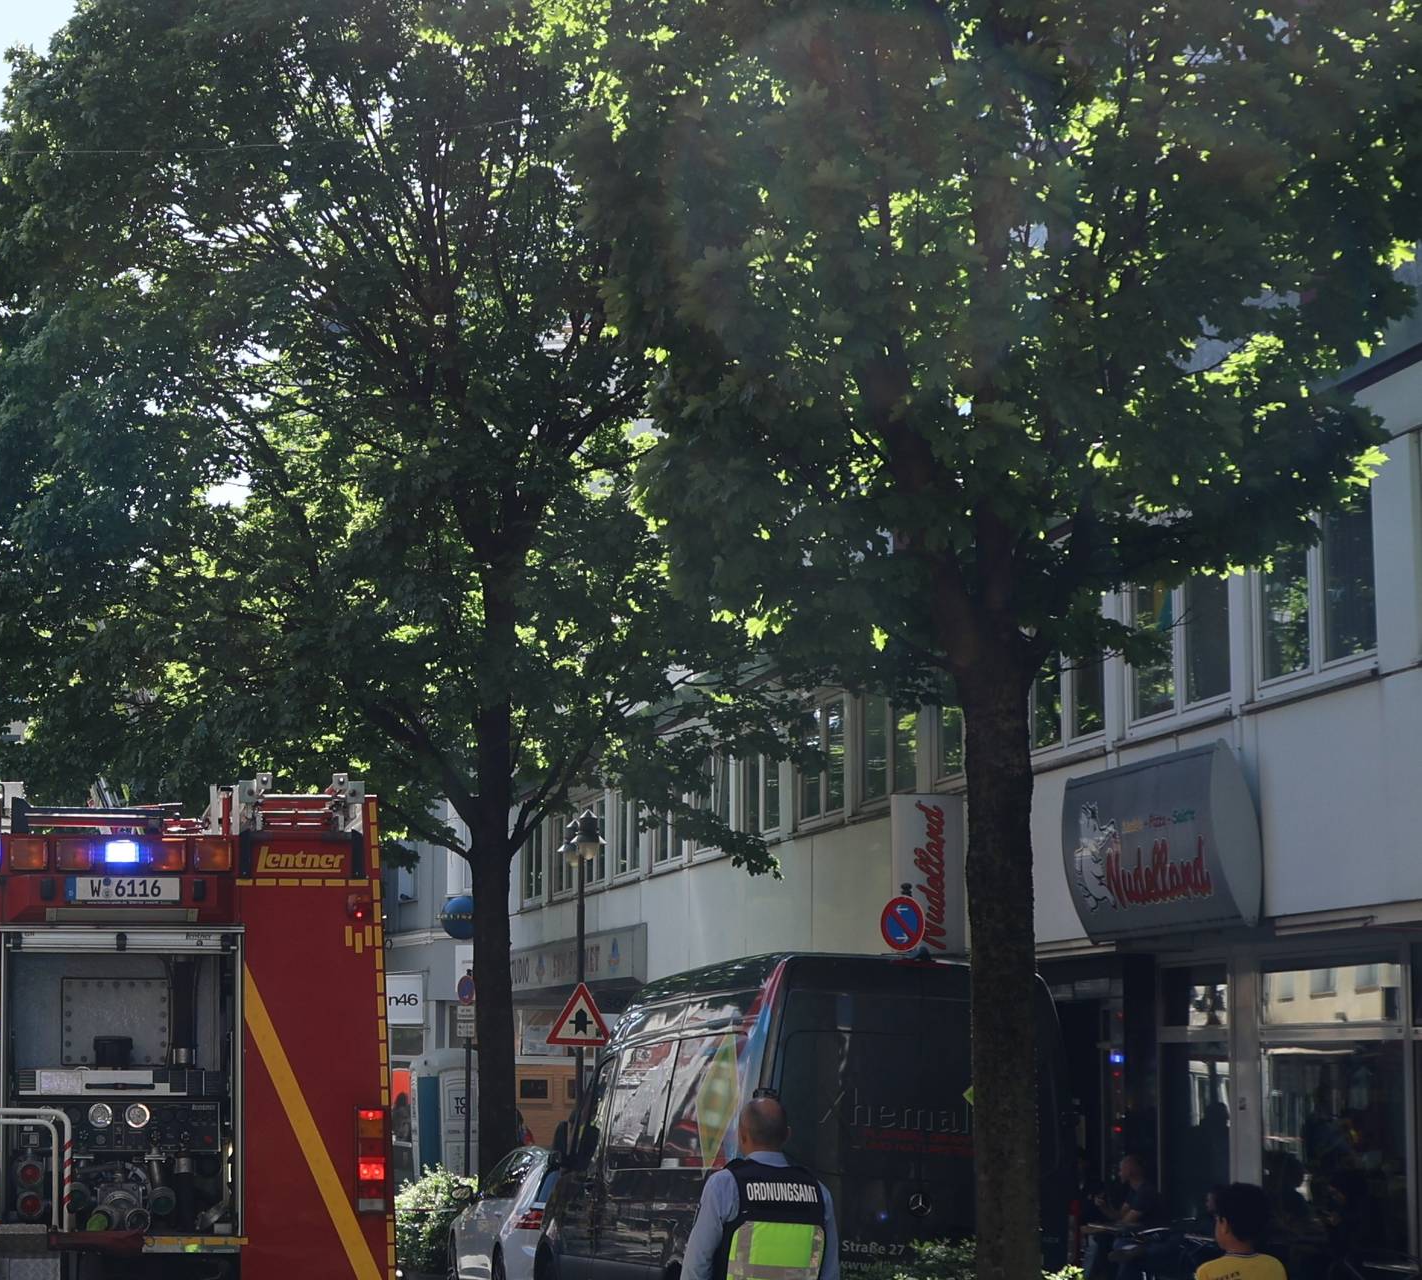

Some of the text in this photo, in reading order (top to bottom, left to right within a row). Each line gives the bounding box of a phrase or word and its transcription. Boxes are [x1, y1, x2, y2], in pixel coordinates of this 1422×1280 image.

[1104, 834, 1213, 909] Nudelland
[90, 879, 102, 897] W
[114, 879, 162, 898] 6116
[388, 993, 419, 1006] n46
[746, 1182, 818, 1204] ORDNUNGSAMT
[842, 1239, 906, 1257] Straße 27
